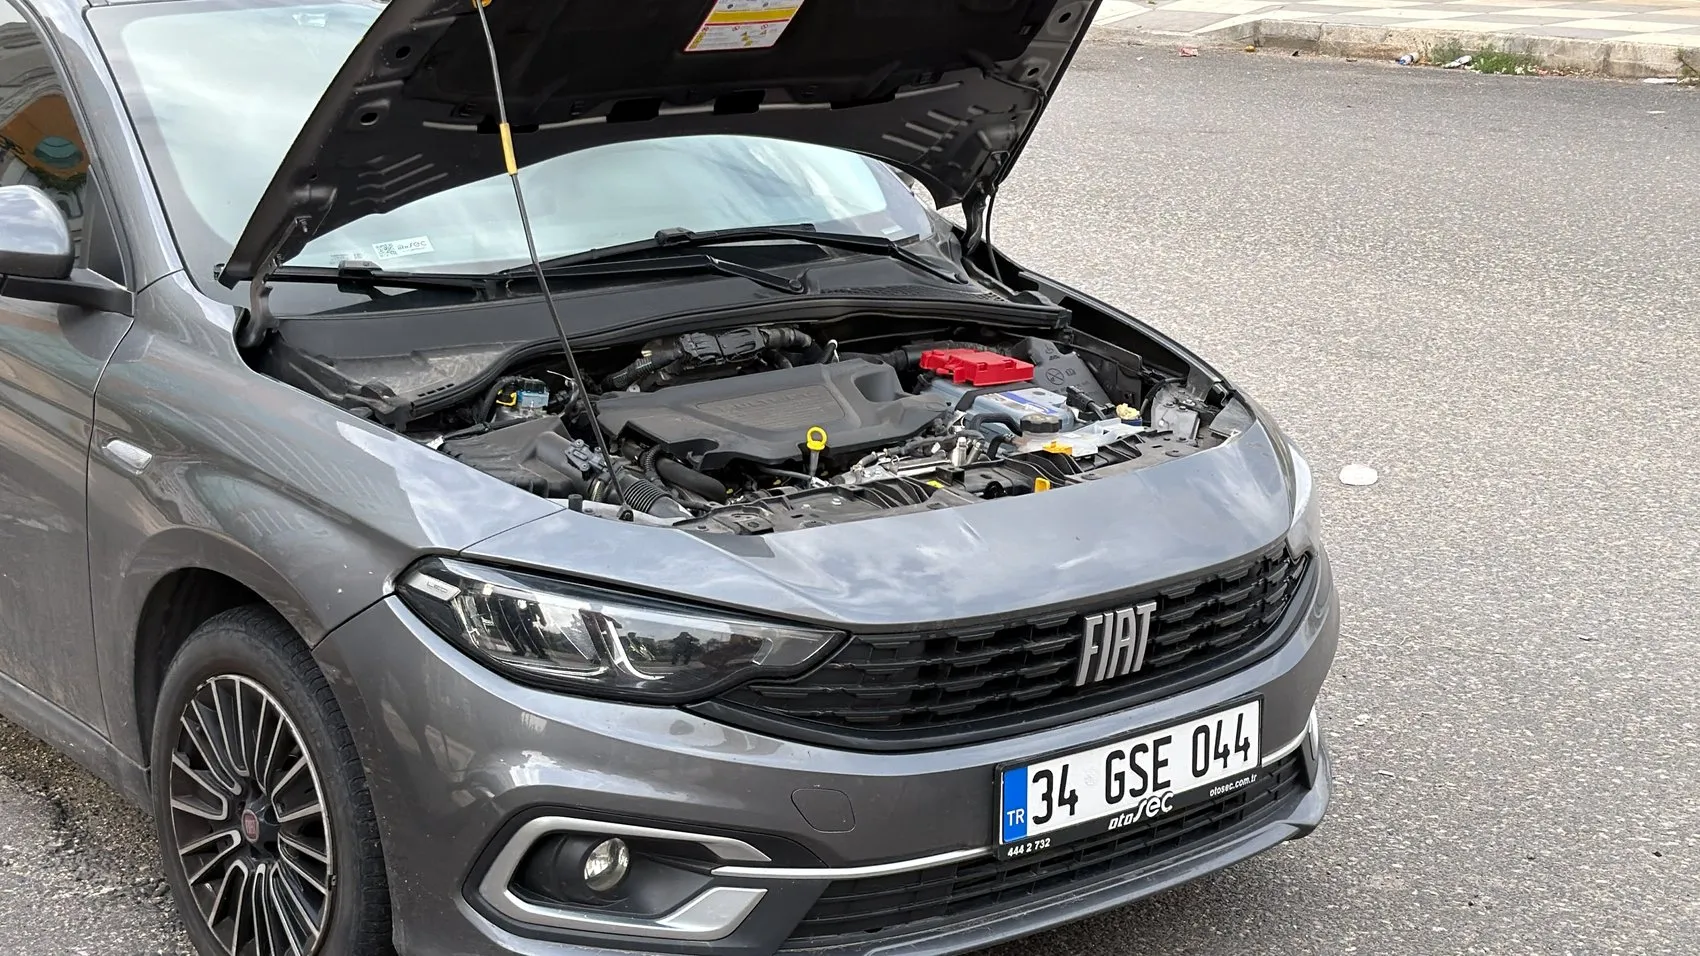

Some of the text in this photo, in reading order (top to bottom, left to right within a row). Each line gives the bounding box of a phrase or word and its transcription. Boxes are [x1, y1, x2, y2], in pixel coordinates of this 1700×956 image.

[426, 581, 448, 593] LED
[1076, 602, 1157, 687] FIAT
[1032, 713, 1250, 825] 34 GSE 044
[1209, 773, 1258, 797] otosec.com.tr
[1006, 808, 1025, 827] TR
[1007, 837, 1051, 857] 444 2 732
